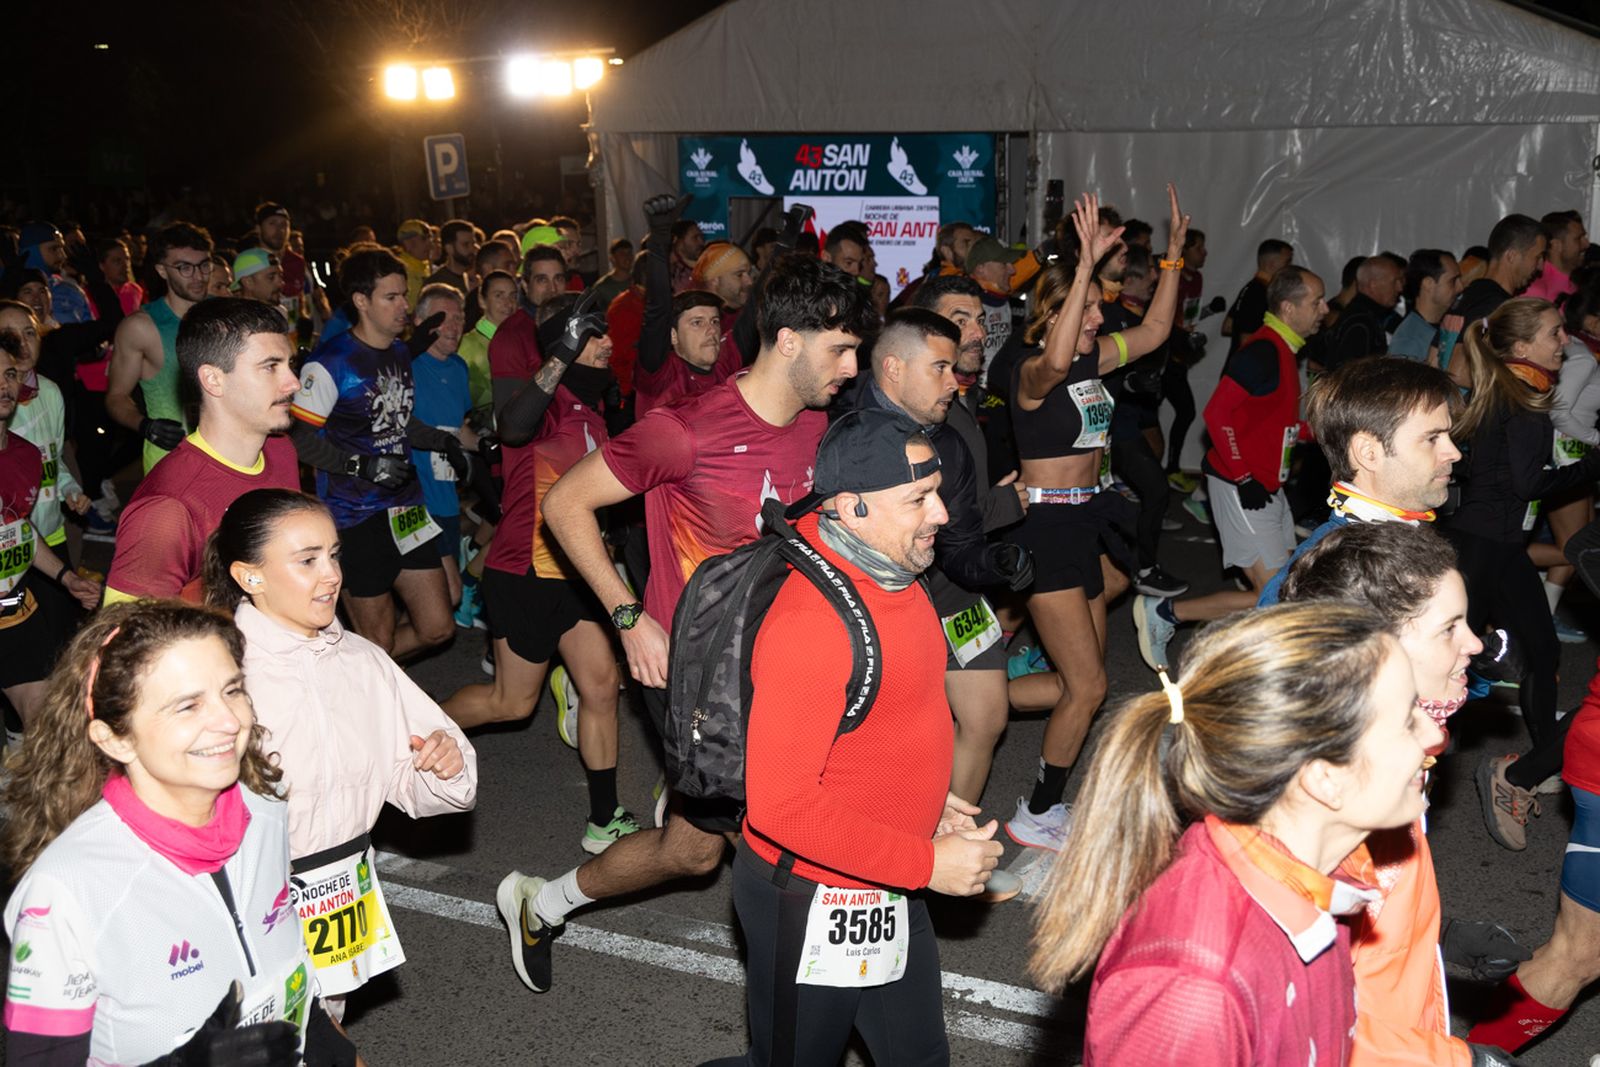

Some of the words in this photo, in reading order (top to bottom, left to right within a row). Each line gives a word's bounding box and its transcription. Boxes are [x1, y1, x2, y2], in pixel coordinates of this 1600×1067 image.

[794, 143, 823, 169] 43
[823, 143, 871, 167] SAN
[434, 143, 459, 192] P
[748, 170, 762, 186] 43
[789, 163, 867, 191] ANTÓN
[899, 169, 914, 186] 43
[865, 222, 898, 238] SAN
[900, 222, 941, 238] ANT
[815, 559, 835, 579] FILA
[838, 586, 856, 608] FILA
[857, 618, 871, 645] FILA
[864, 658, 875, 685] FILA
[846, 696, 866, 718] FILA
[302, 880, 338, 902] NOCHE
[339, 874, 351, 889] DE
[822, 893, 849, 905] SAN
[298, 903, 316, 919] AN
[319, 889, 355, 915] ANTÓN
[308, 900, 368, 955] 2770
[828, 905, 895, 945] 3585
[330, 951, 348, 965] ANA
[846, 948, 862, 957] Luis
[862, 946, 882, 956] Carlos
[170, 959, 205, 981] mobel
[261, 998, 276, 1019] DE
